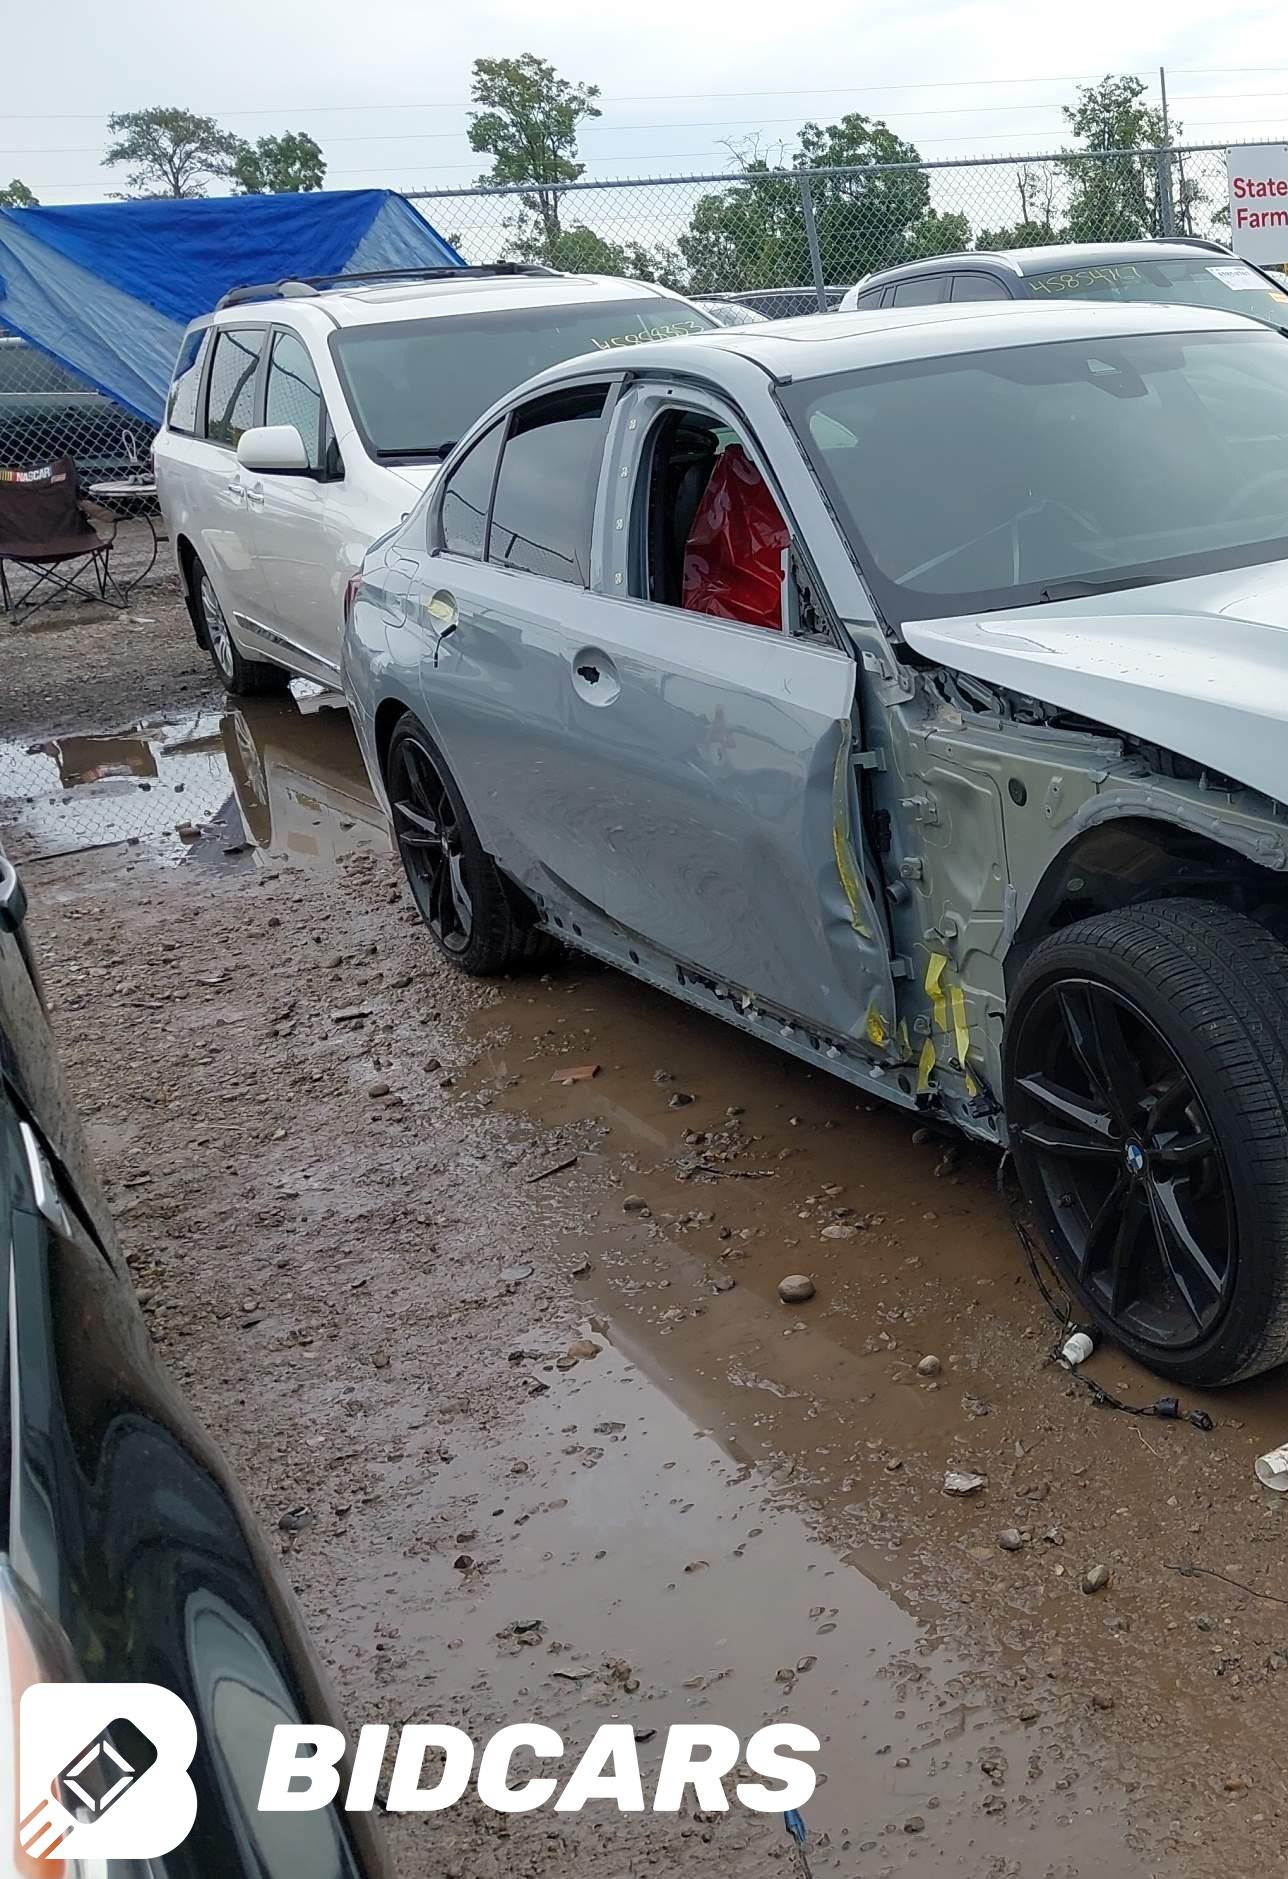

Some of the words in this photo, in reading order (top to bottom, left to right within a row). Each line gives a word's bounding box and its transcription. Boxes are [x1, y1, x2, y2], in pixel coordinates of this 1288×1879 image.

[1233, 177, 1288, 198] State
[1236, 207, 1288, 229] Farm
[16, 465, 51, 482] NASCAR
